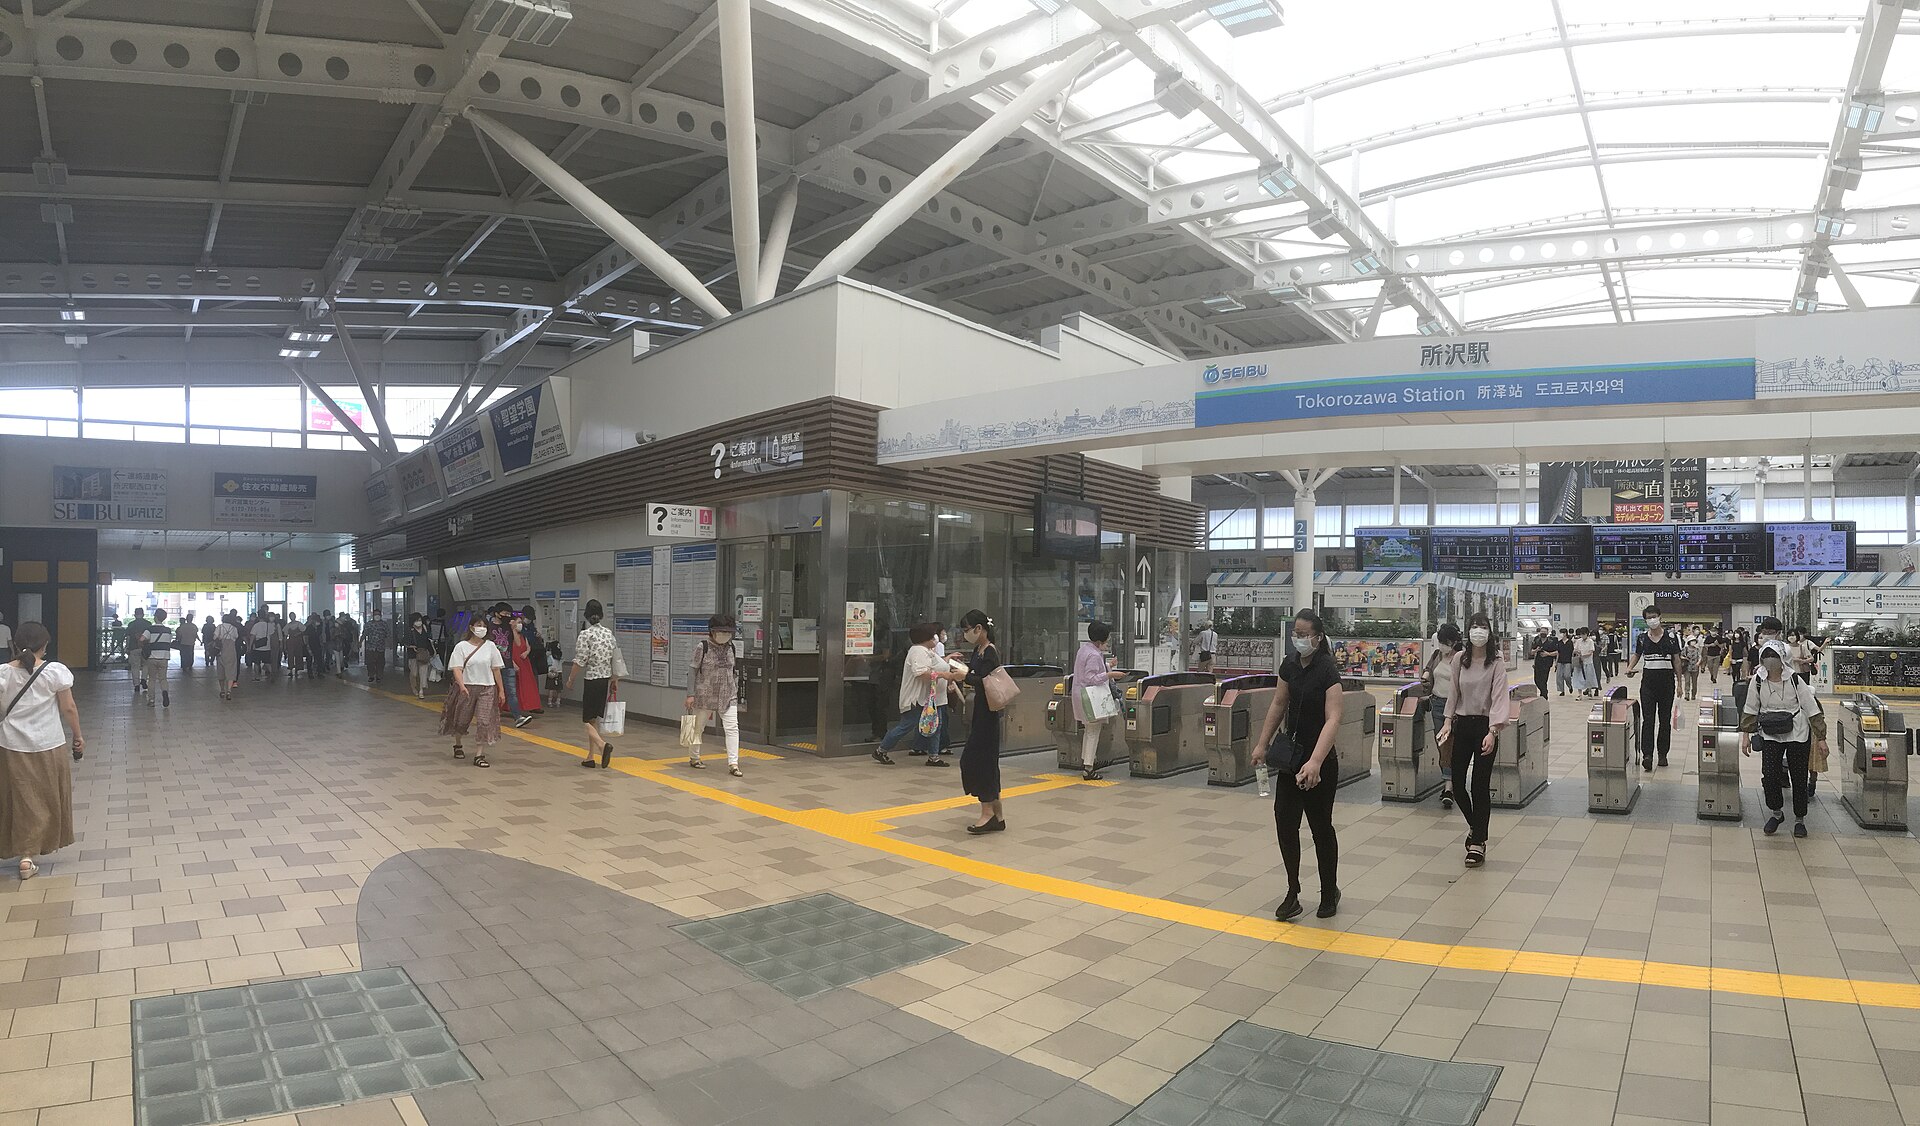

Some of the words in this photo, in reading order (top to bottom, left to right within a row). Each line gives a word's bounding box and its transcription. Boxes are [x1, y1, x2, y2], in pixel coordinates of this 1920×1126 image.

[1420, 342, 1490, 367] 所沢駅
[1221, 364, 1268, 380] SEIBU
[1477, 383, 1523, 400] 所泽站
[1535, 378, 1625, 397] 도코로자와역
[1295, 391, 1398, 410] Tokorozawa
[1402, 386, 1465, 403] Station
[731, 440, 756, 457] ご案内
[731, 457, 762, 469] Information
[242, 482, 307, 493] 住友不動産販売
[671, 508, 692, 517] ご案内
[1297, 522, 1304, 534] 2
[1297, 539, 1304, 550] 3
[1673, 590, 1689, 600] Style
